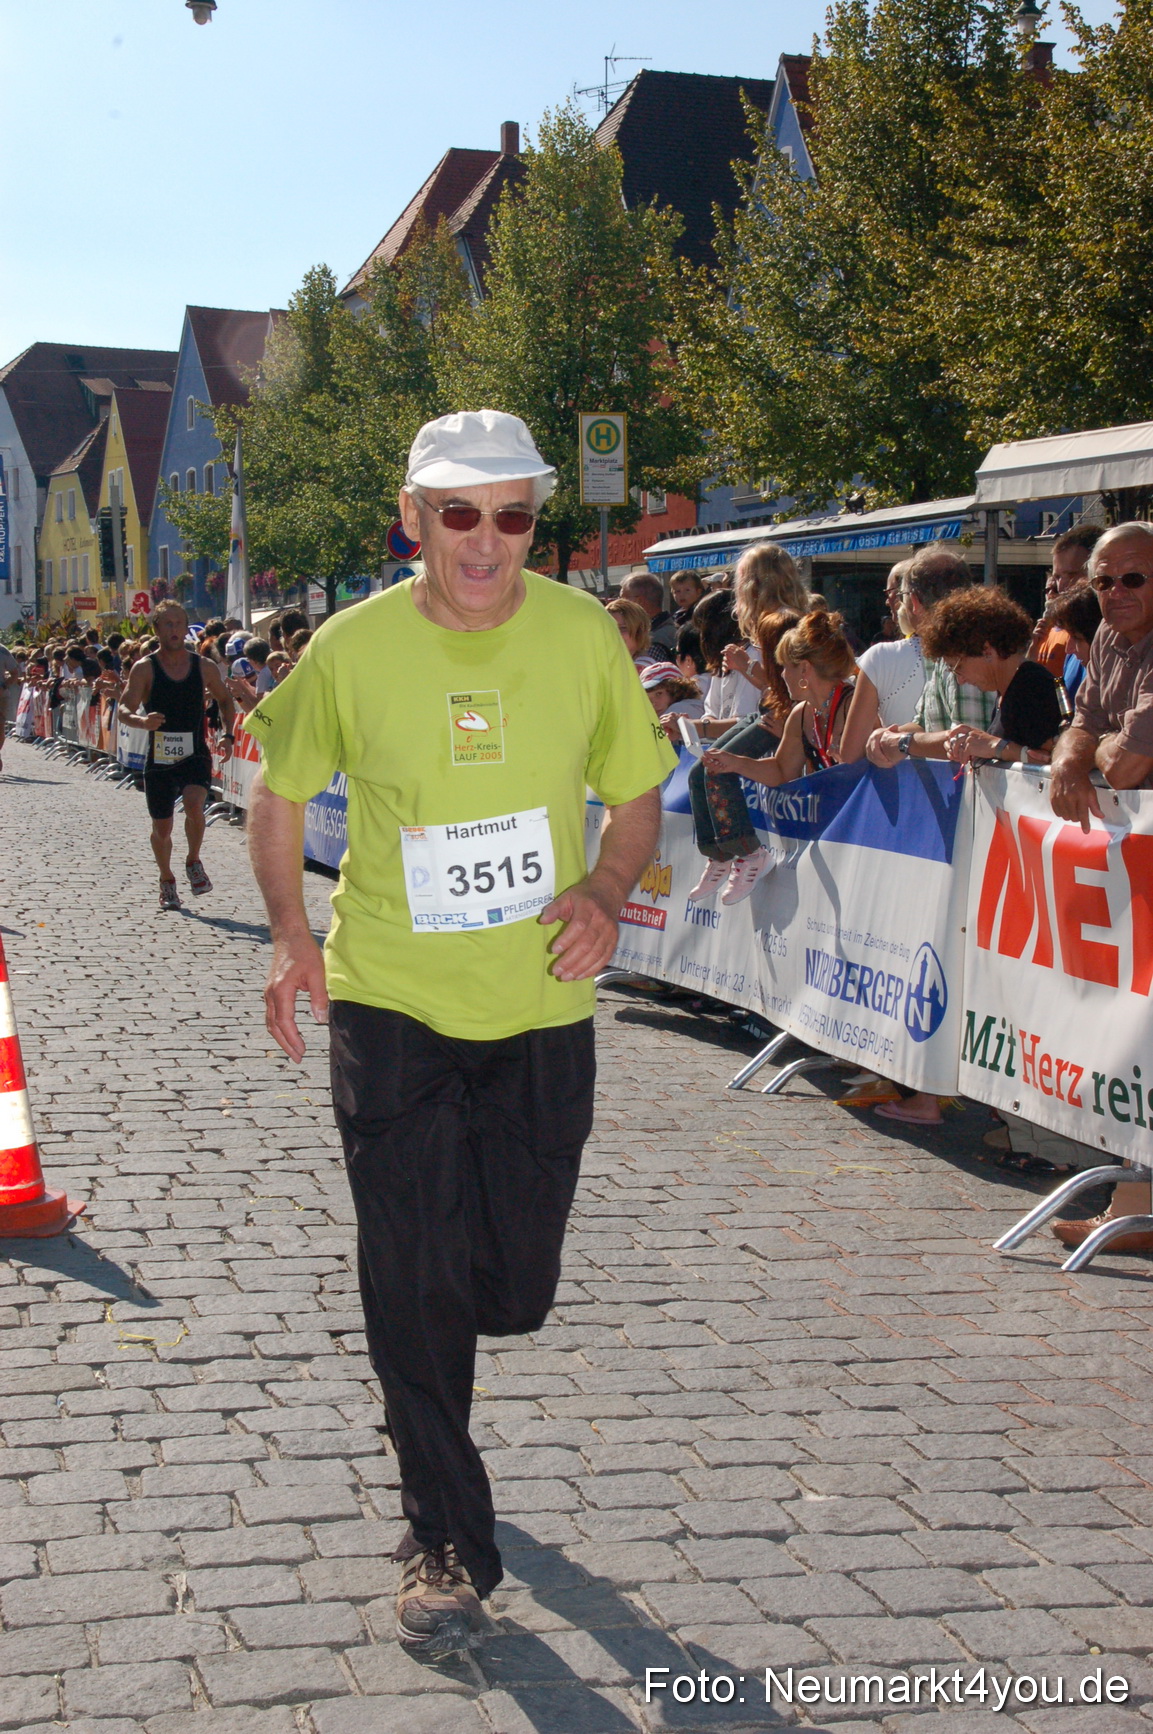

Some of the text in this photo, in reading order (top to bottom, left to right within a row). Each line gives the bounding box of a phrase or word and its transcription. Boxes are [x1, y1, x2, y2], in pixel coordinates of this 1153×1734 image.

[164, 746, 184, 756] 548
[454, 751, 502, 761] LAUF 2005
[446, 816, 518, 840] Hartmut
[447, 850, 543, 897] 3515
[415, 912, 468, 925] BOCK
[684, 897, 722, 930] Pirner
[806, 917, 826, 934] Schutz
[853, 932, 863, 945] im
[863, 932, 888, 951] Zeichen
[889, 942, 900, 955] der
[899, 943, 911, 962] Burg
[680, 955, 711, 982] Unterer
[732, 973, 745, 993] 23
